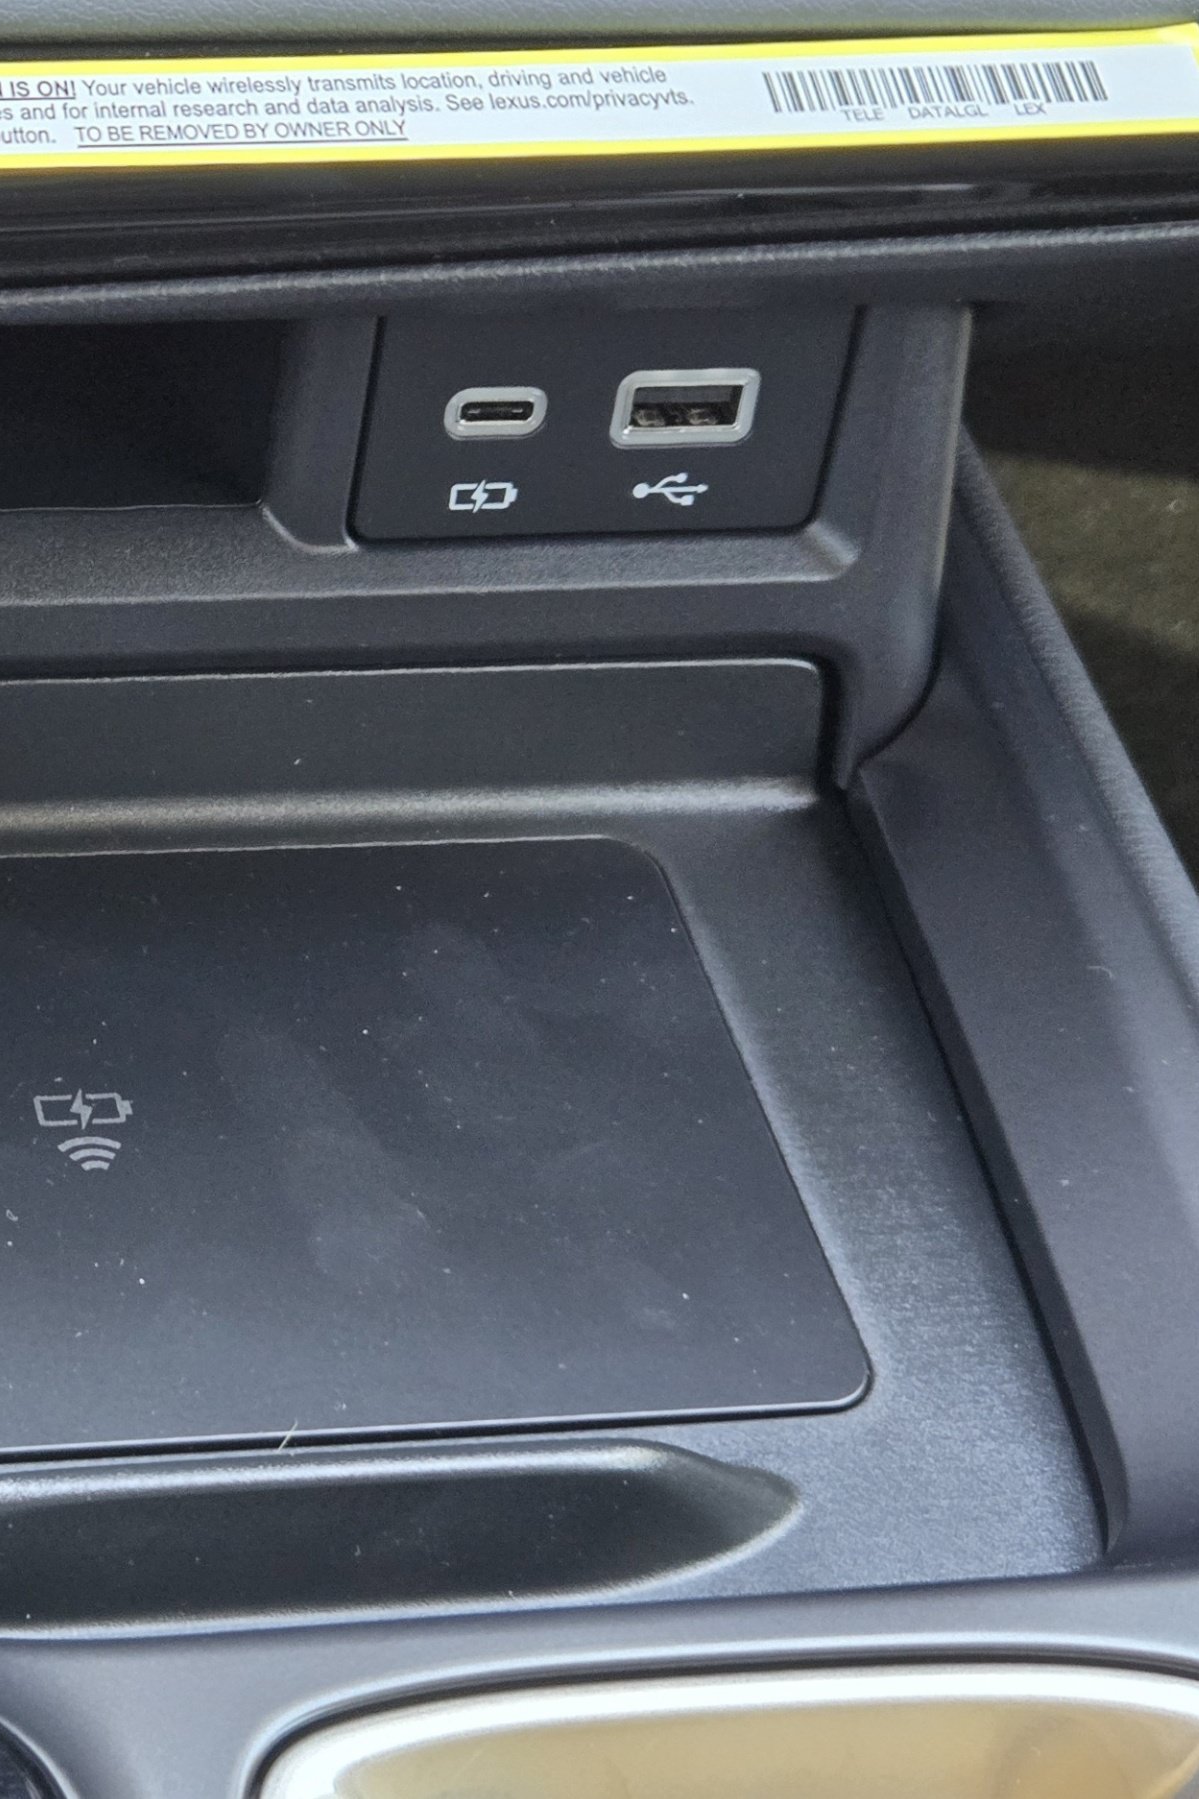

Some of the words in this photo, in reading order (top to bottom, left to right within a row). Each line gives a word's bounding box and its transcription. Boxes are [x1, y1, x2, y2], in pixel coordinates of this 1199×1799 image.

[10, 82, 30, 98] IS
[36, 81, 76, 97] ON!
[81, 80, 127, 96] Your
[133, 78, 201, 95] vehicle
[208, 76, 300, 97] wirelessly
[308, 75, 397, 92] transmits
[402, 72, 483, 90] location,
[488, 70, 551, 89] driving
[558, 68, 594, 85] and
[600, 66, 667, 83] vehicle
[20, 103, 56, 120] and
[62, 102, 88, 119] for
[94, 101, 166, 119] internal
[173, 99, 258, 117] research
[265, 98, 300, 115] and
[308, 97, 350, 114] data
[356, 95, 440, 117] analysis.
[446, 94, 484, 111] See
[490, 89, 694, 112] lexus.com/privacyvts.
[841, 107, 884, 122] TELE
[908, 105, 989, 121] DATALGL
[1014, 103, 1049, 117] LEX
[74, 126, 102, 142] TO
[108, 125, 134, 141] BE
[140, 124, 238, 141] REMOVED
[244, 123, 269, 139] BY
[275, 121, 350, 138] OWNER
[355, 119, 407, 136] ONLY
